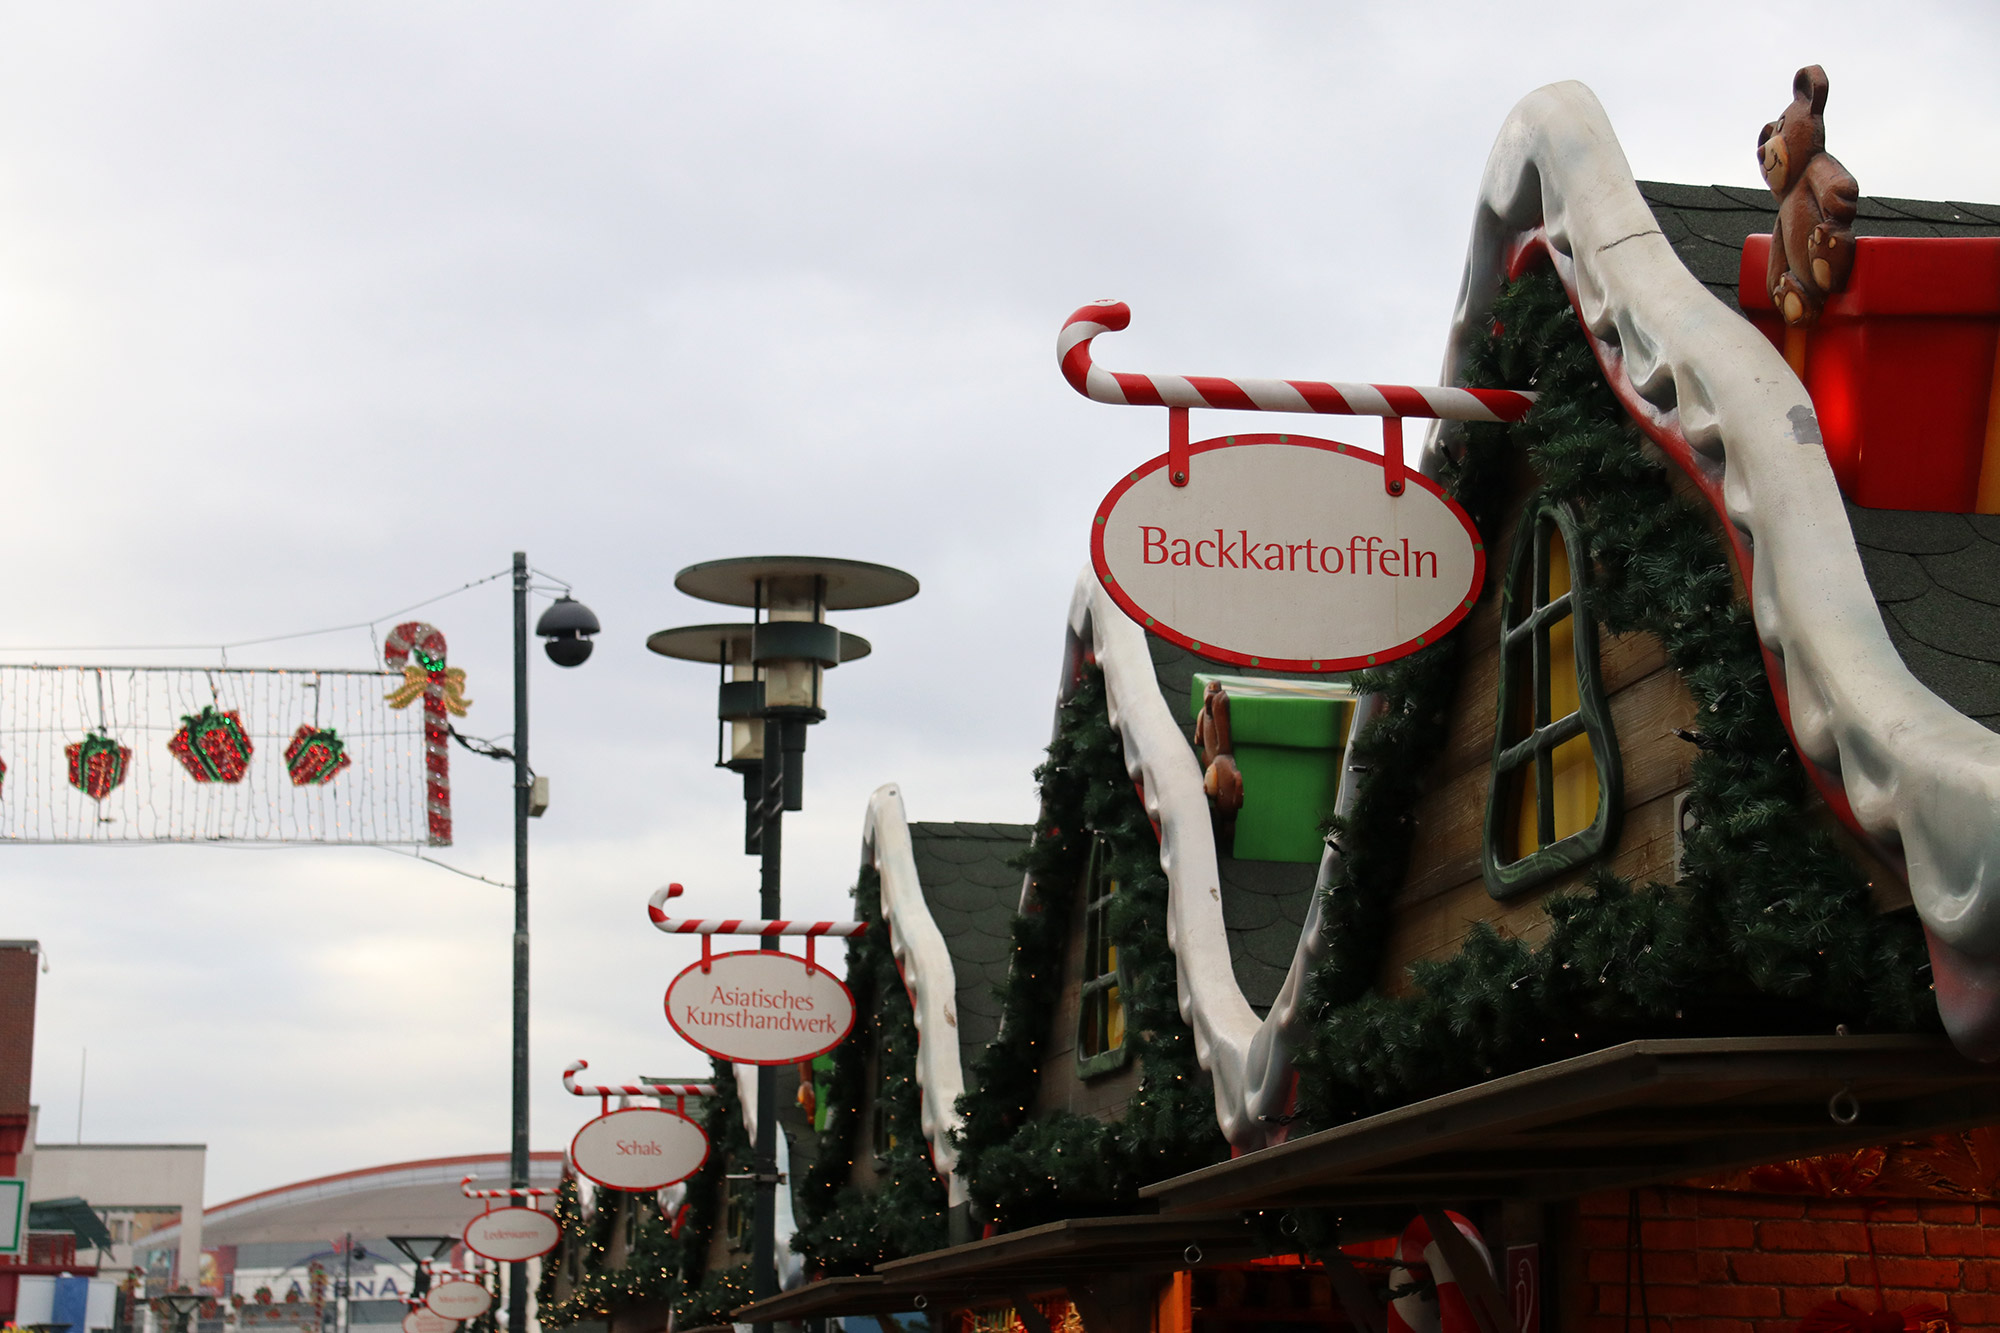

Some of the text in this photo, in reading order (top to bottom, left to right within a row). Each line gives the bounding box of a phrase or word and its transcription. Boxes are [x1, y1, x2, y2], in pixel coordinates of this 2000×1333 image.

[1138, 525, 1438, 578] Backkartoffeln
[711, 986, 814, 1010] Asiatisches
[686, 1005, 837, 1034] Kunsthandwerk
[616, 1140, 662, 1155] Schals
[288, 1277, 399, 1299] AENA
